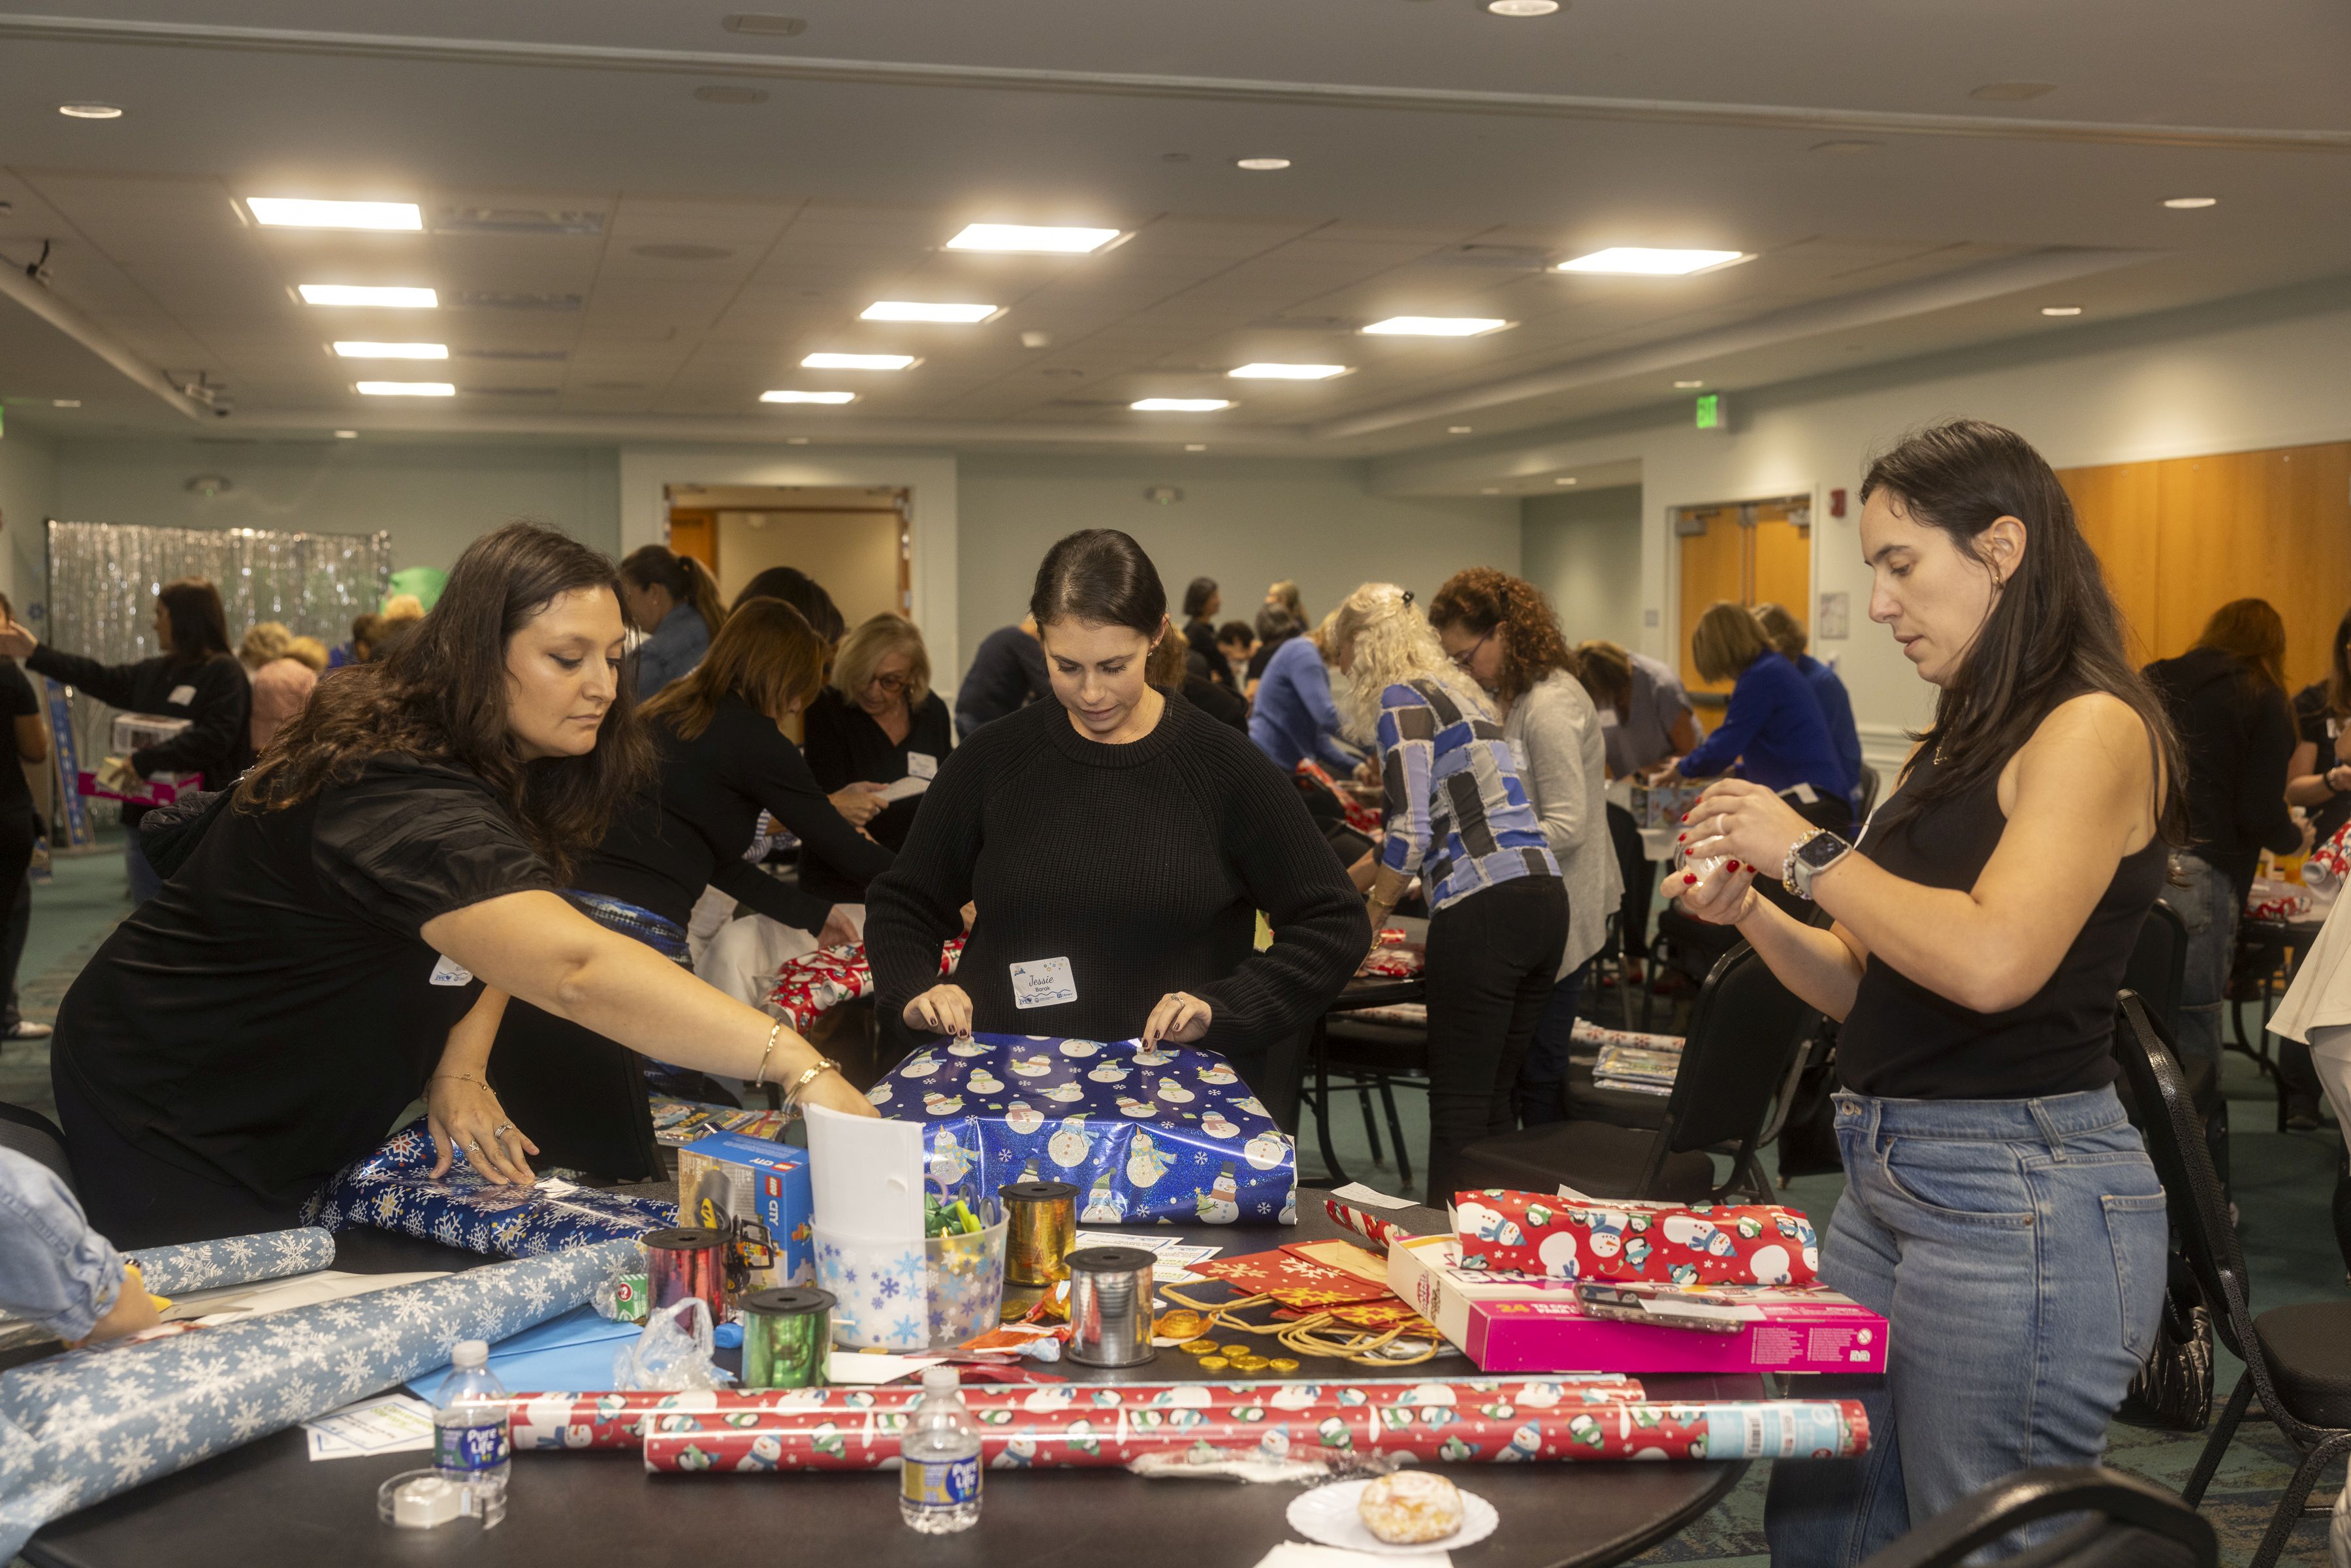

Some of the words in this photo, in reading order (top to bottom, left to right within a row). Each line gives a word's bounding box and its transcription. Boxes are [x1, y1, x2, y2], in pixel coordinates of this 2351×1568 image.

[1029, 975, 1053, 987] Jessie
[748, 1157, 774, 1166] CITY
[769, 1199, 779, 1227] CITY
[466, 1428, 498, 1443] Pure
[470, 1439, 494, 1456] Life
[952, 1461, 978, 1478] Pure
[955, 1473, 976, 1490] Life
